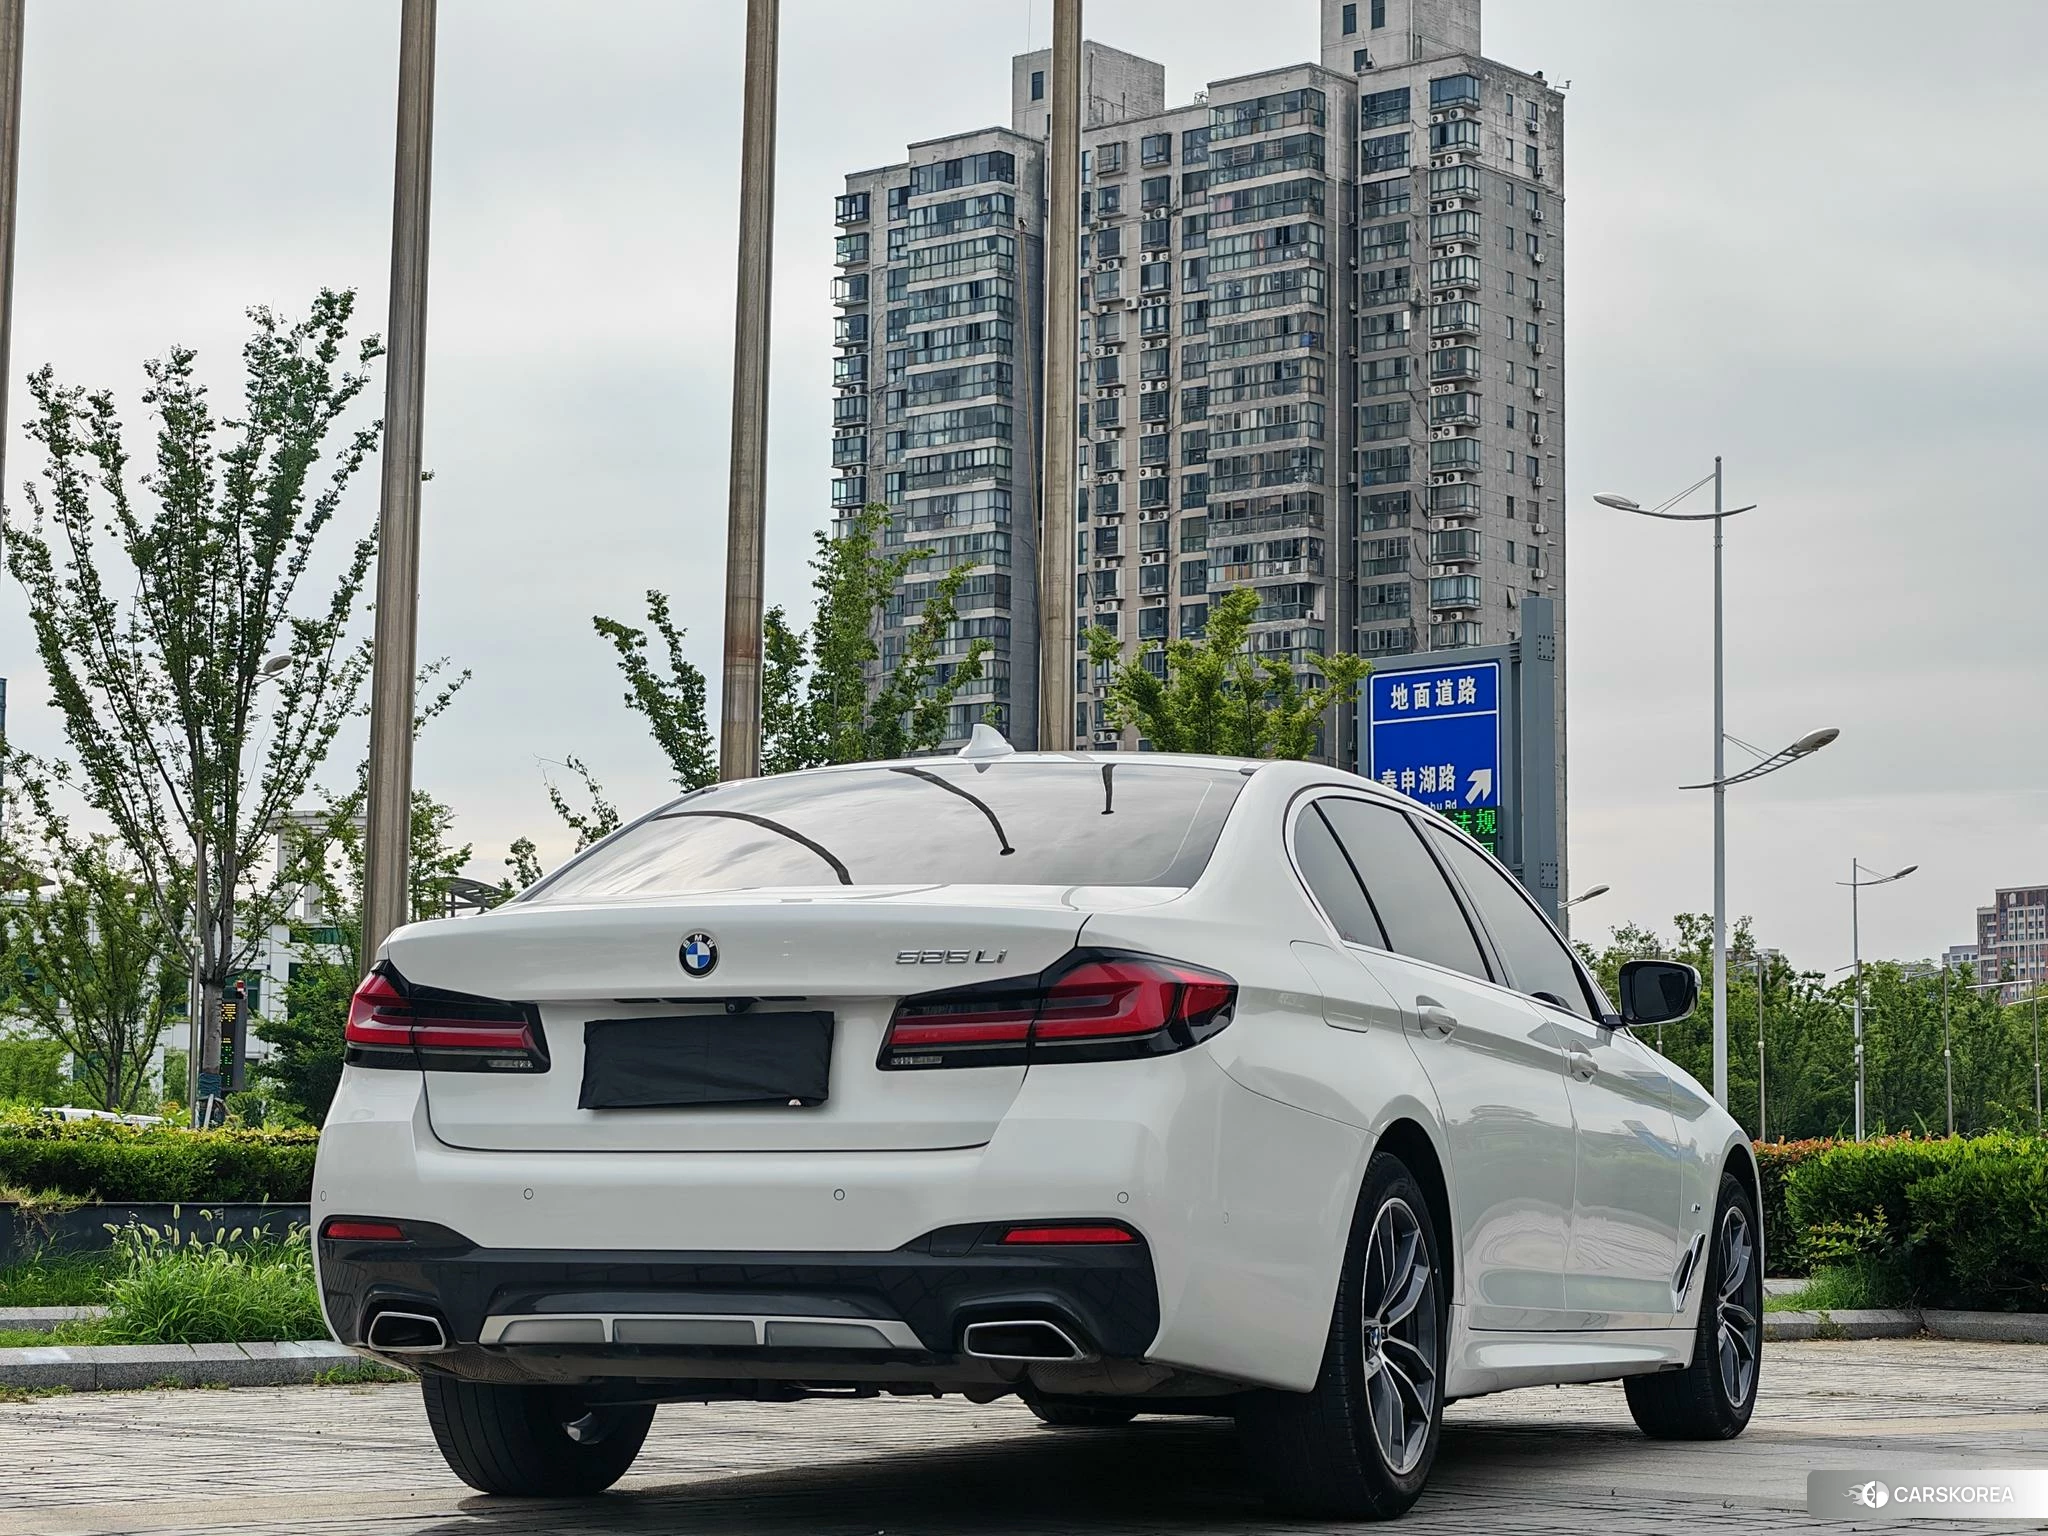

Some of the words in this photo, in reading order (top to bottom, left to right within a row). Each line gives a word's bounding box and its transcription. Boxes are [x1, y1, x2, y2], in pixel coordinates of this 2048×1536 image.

[1390, 675, 1477, 711] 地面道路
[1445, 799, 1457, 810] Rd
[682, 934, 715, 949] BMW
